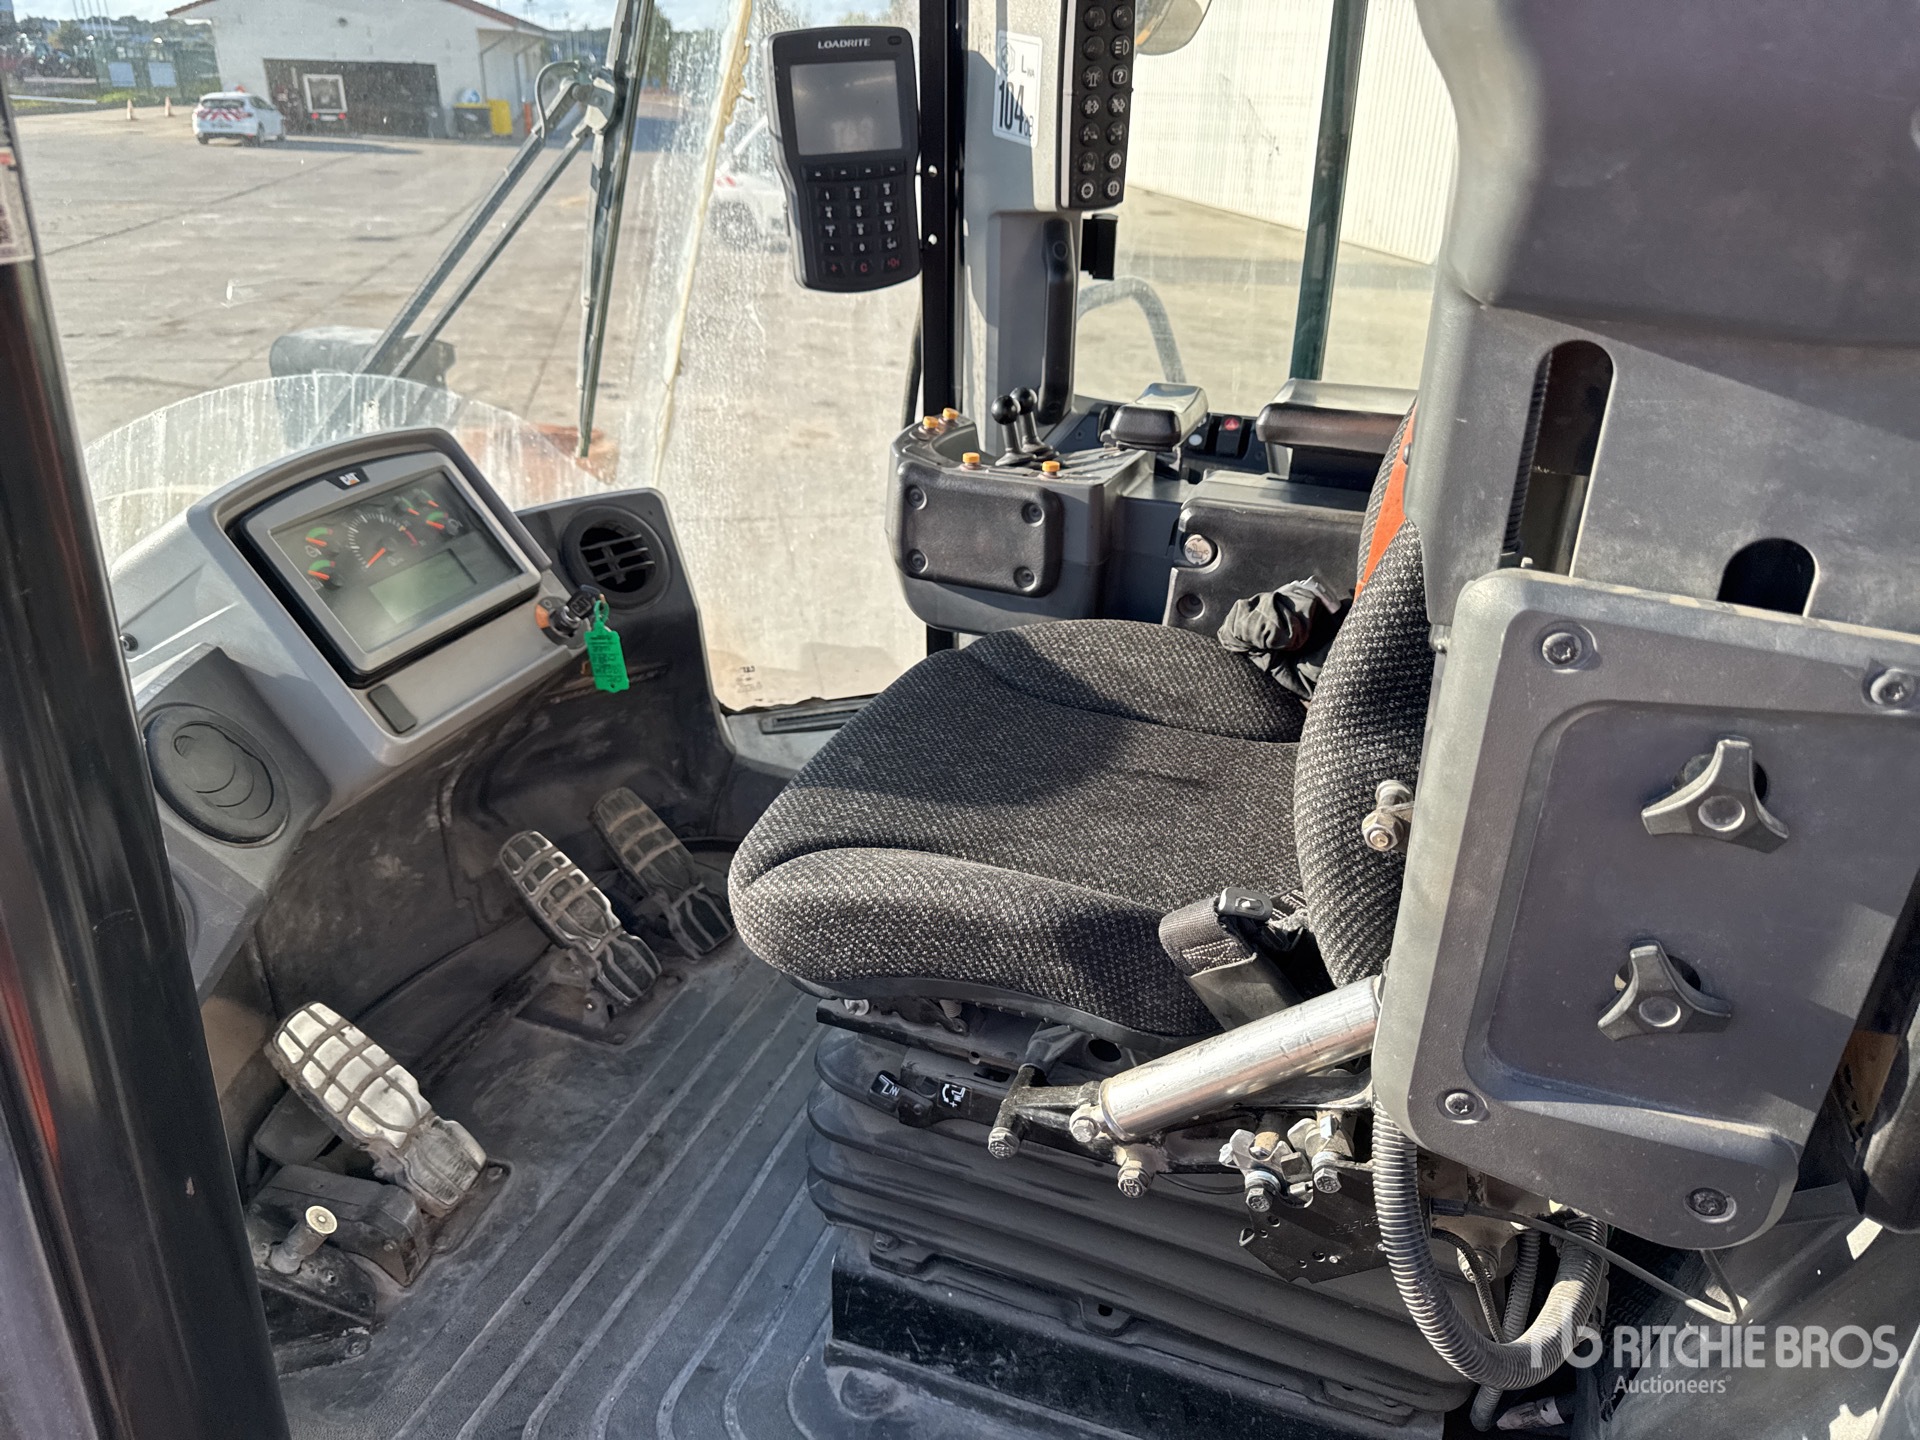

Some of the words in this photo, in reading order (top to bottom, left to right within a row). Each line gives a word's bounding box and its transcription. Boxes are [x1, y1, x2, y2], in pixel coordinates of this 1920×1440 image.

[817, 38, 872, 49] LOADRITE
[999, 80, 1025, 134] 104
[339, 472, 361, 486] CAT
